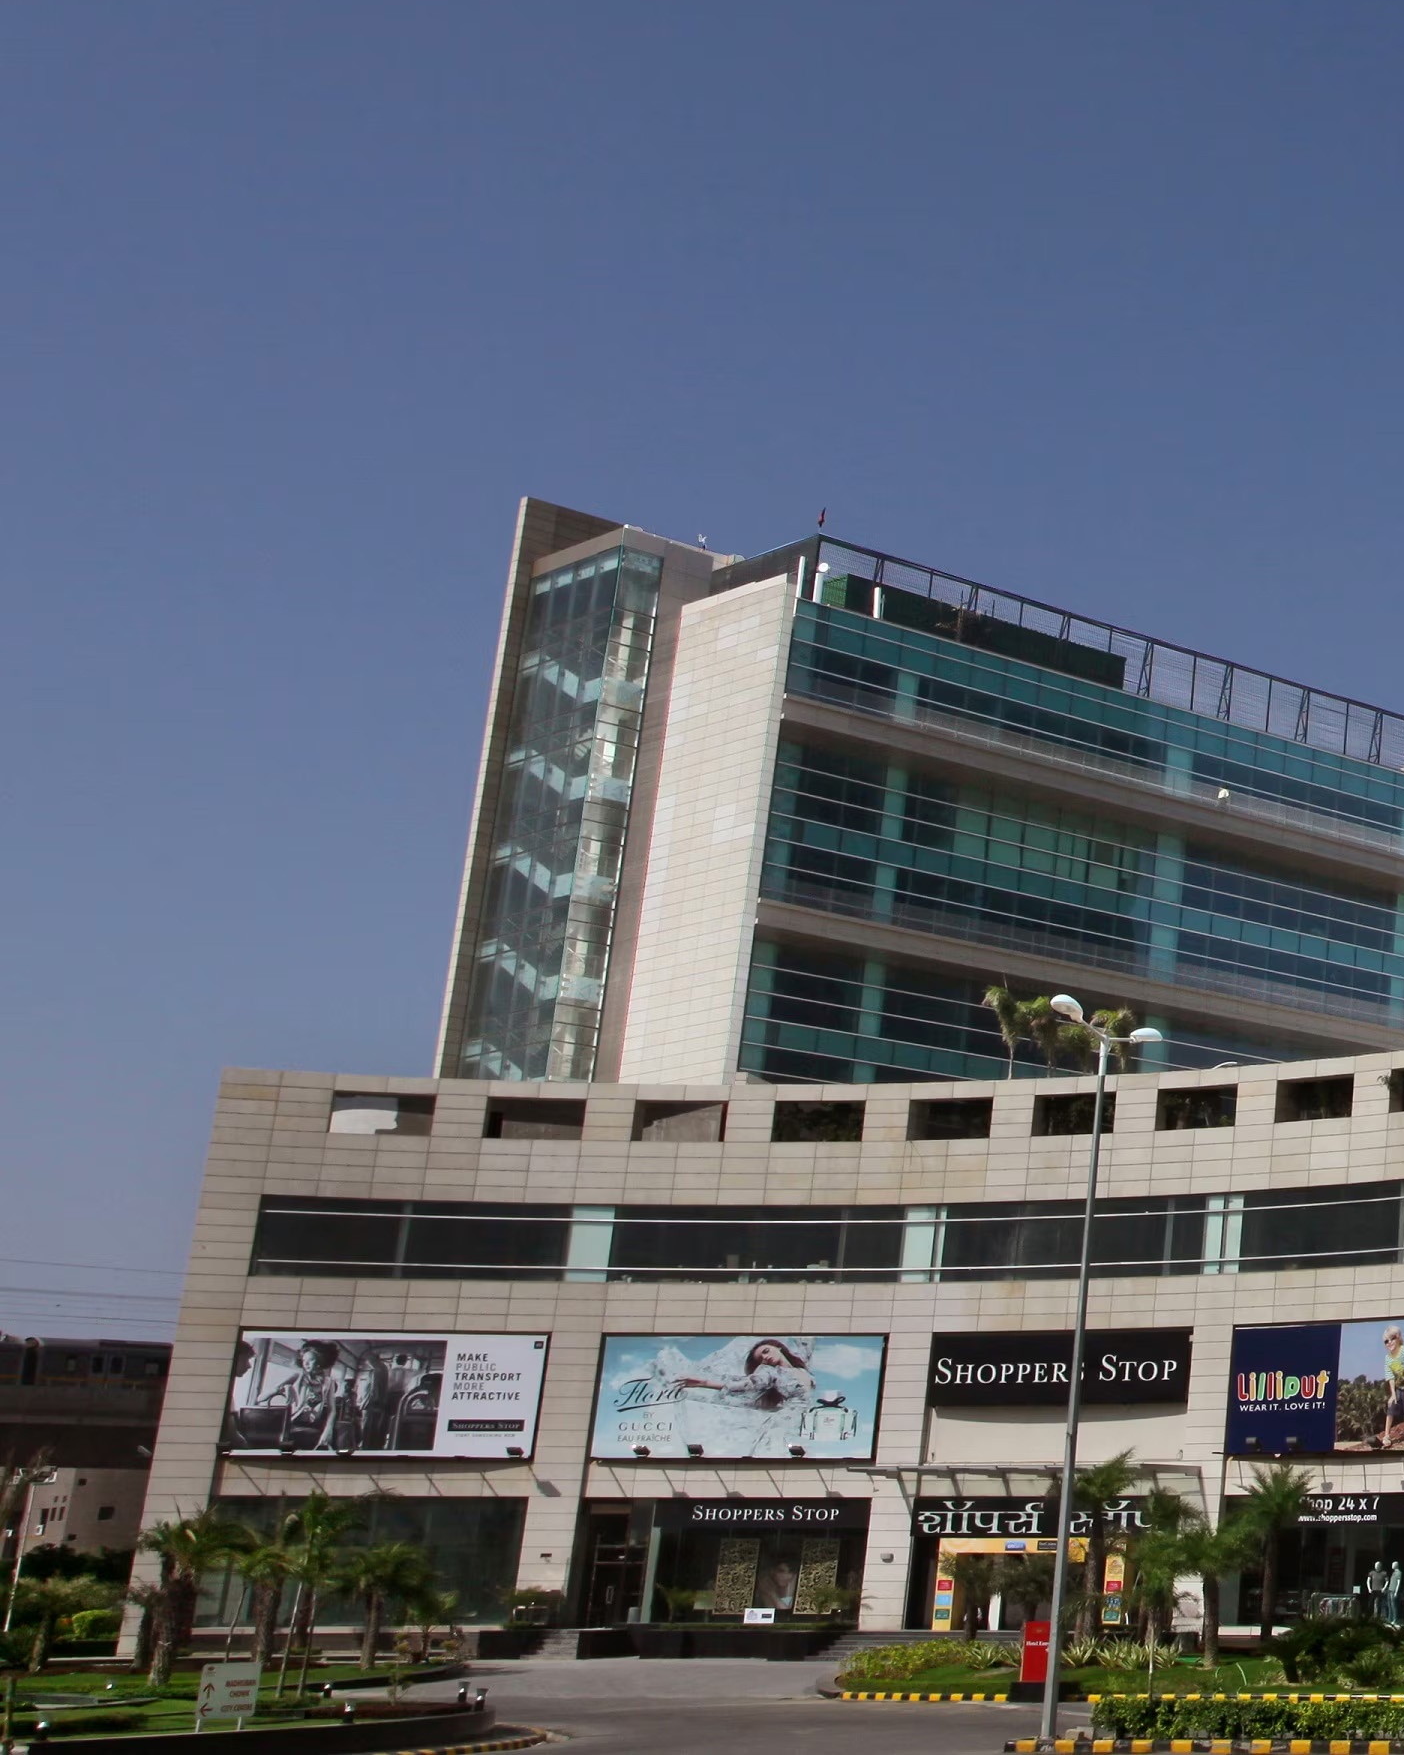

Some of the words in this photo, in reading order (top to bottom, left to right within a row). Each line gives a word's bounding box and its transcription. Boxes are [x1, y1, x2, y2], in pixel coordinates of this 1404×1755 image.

[457, 1353, 488, 1362] MAKE
[455, 1363, 496, 1371] PUBLIC
[934, 1357, 1085, 1385] SHOPPER
[1099, 1354, 1178, 1382] STOP
[455, 1372, 522, 1381] TRANSPORT
[453, 1382, 485, 1391] MORE
[1237, 1370, 1330, 1401] Lilliput
[451, 1392, 521, 1401] ATTRACTIVE
[613, 1378, 687, 1407] Flora
[1240, 1404, 1267, 1412] WEAR
[1285, 1403, 1310, 1411] LOVE
[1312, 1402, 1325, 1410] IT!
[642, 1411, 655, 1419] BY
[618, 1422, 673, 1432] GUCCI
[616, 1434, 634, 1443] EAU
[635, 1432, 672, 1443] FRAÎCHE
[1338, 1496, 1355, 1511] 24
[1359, 1498, 1368, 1510] x
[1372, 1495, 1380, 1510] 7
[691, 1505, 785, 1521] SHOPPERS
[791, 1505, 840, 1521] STOP
[917, 1500, 1045, 1534] शॉपर्स
